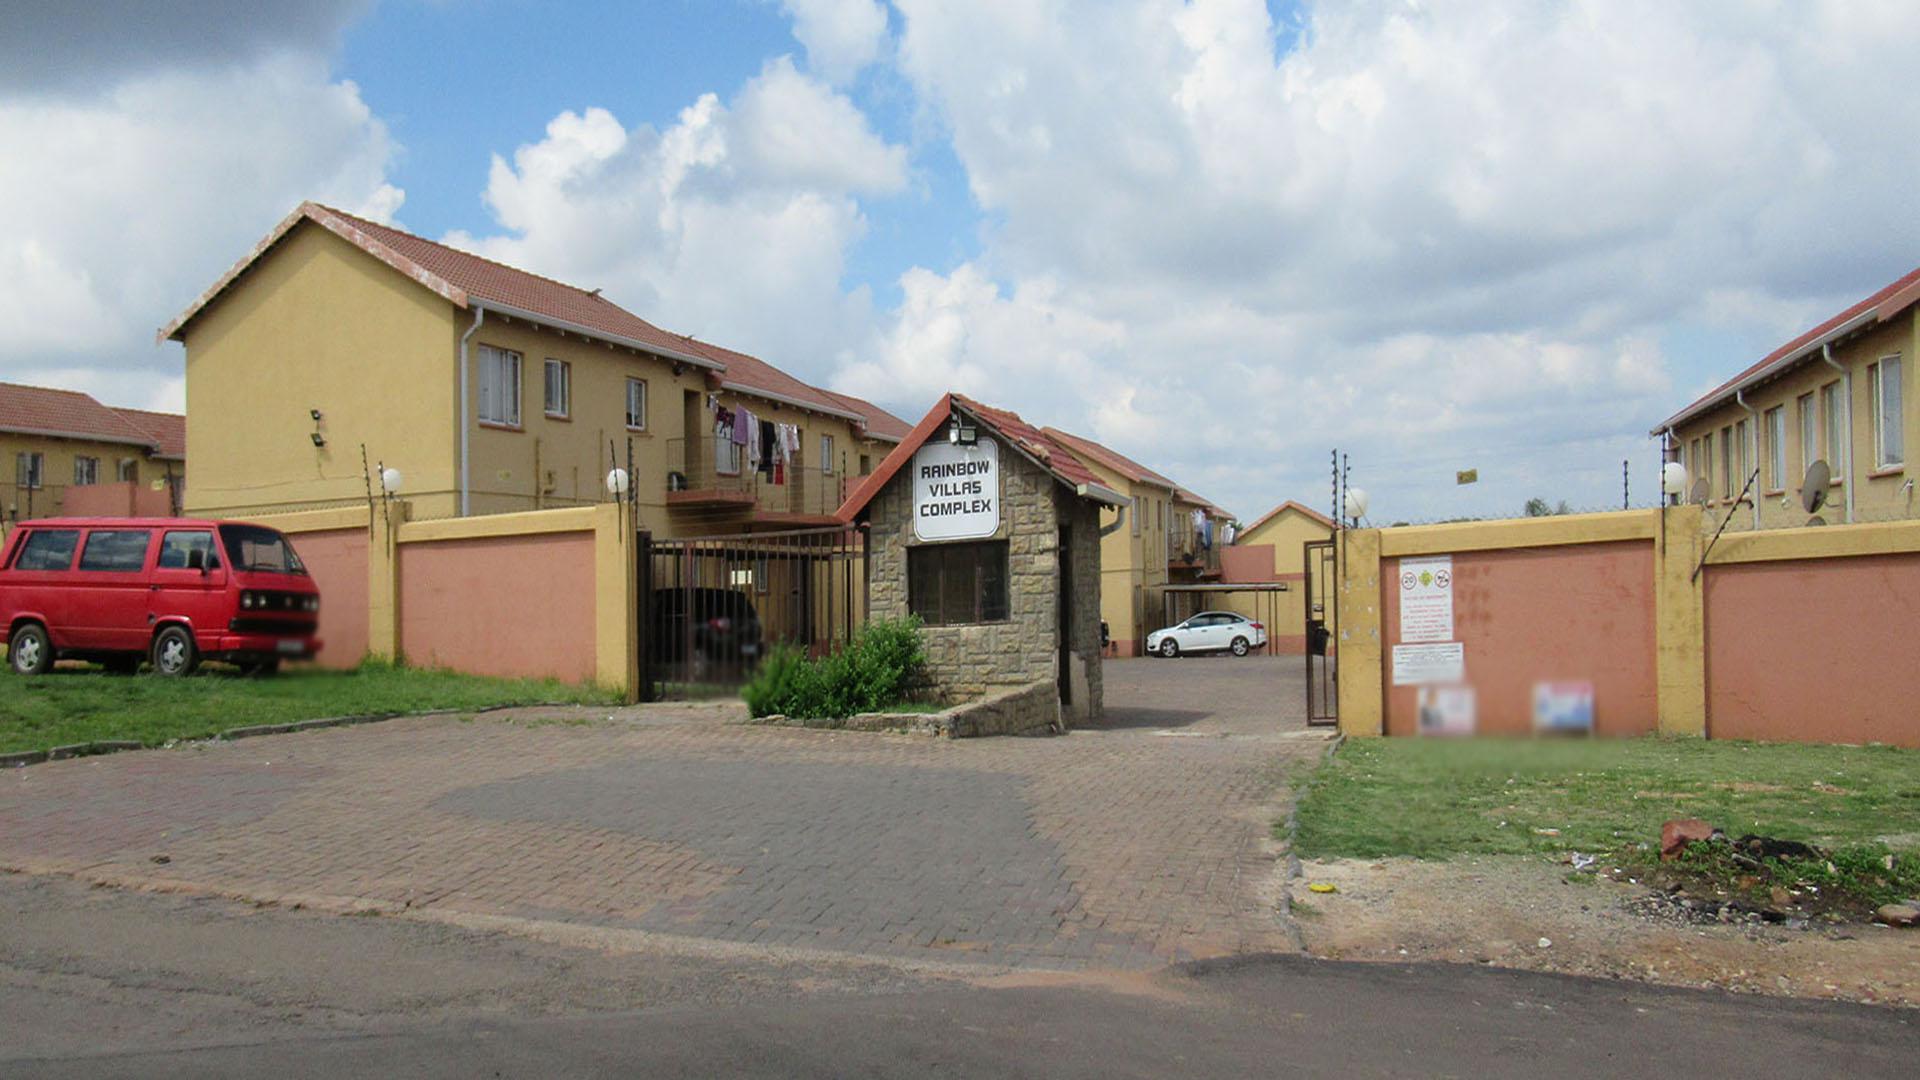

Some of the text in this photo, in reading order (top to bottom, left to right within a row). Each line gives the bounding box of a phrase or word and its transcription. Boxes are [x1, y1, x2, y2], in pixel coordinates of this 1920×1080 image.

[921, 461, 989, 479] RAINBOW
[929, 481, 982, 497] VILLAS
[920, 499, 991, 517] COMPLEX
